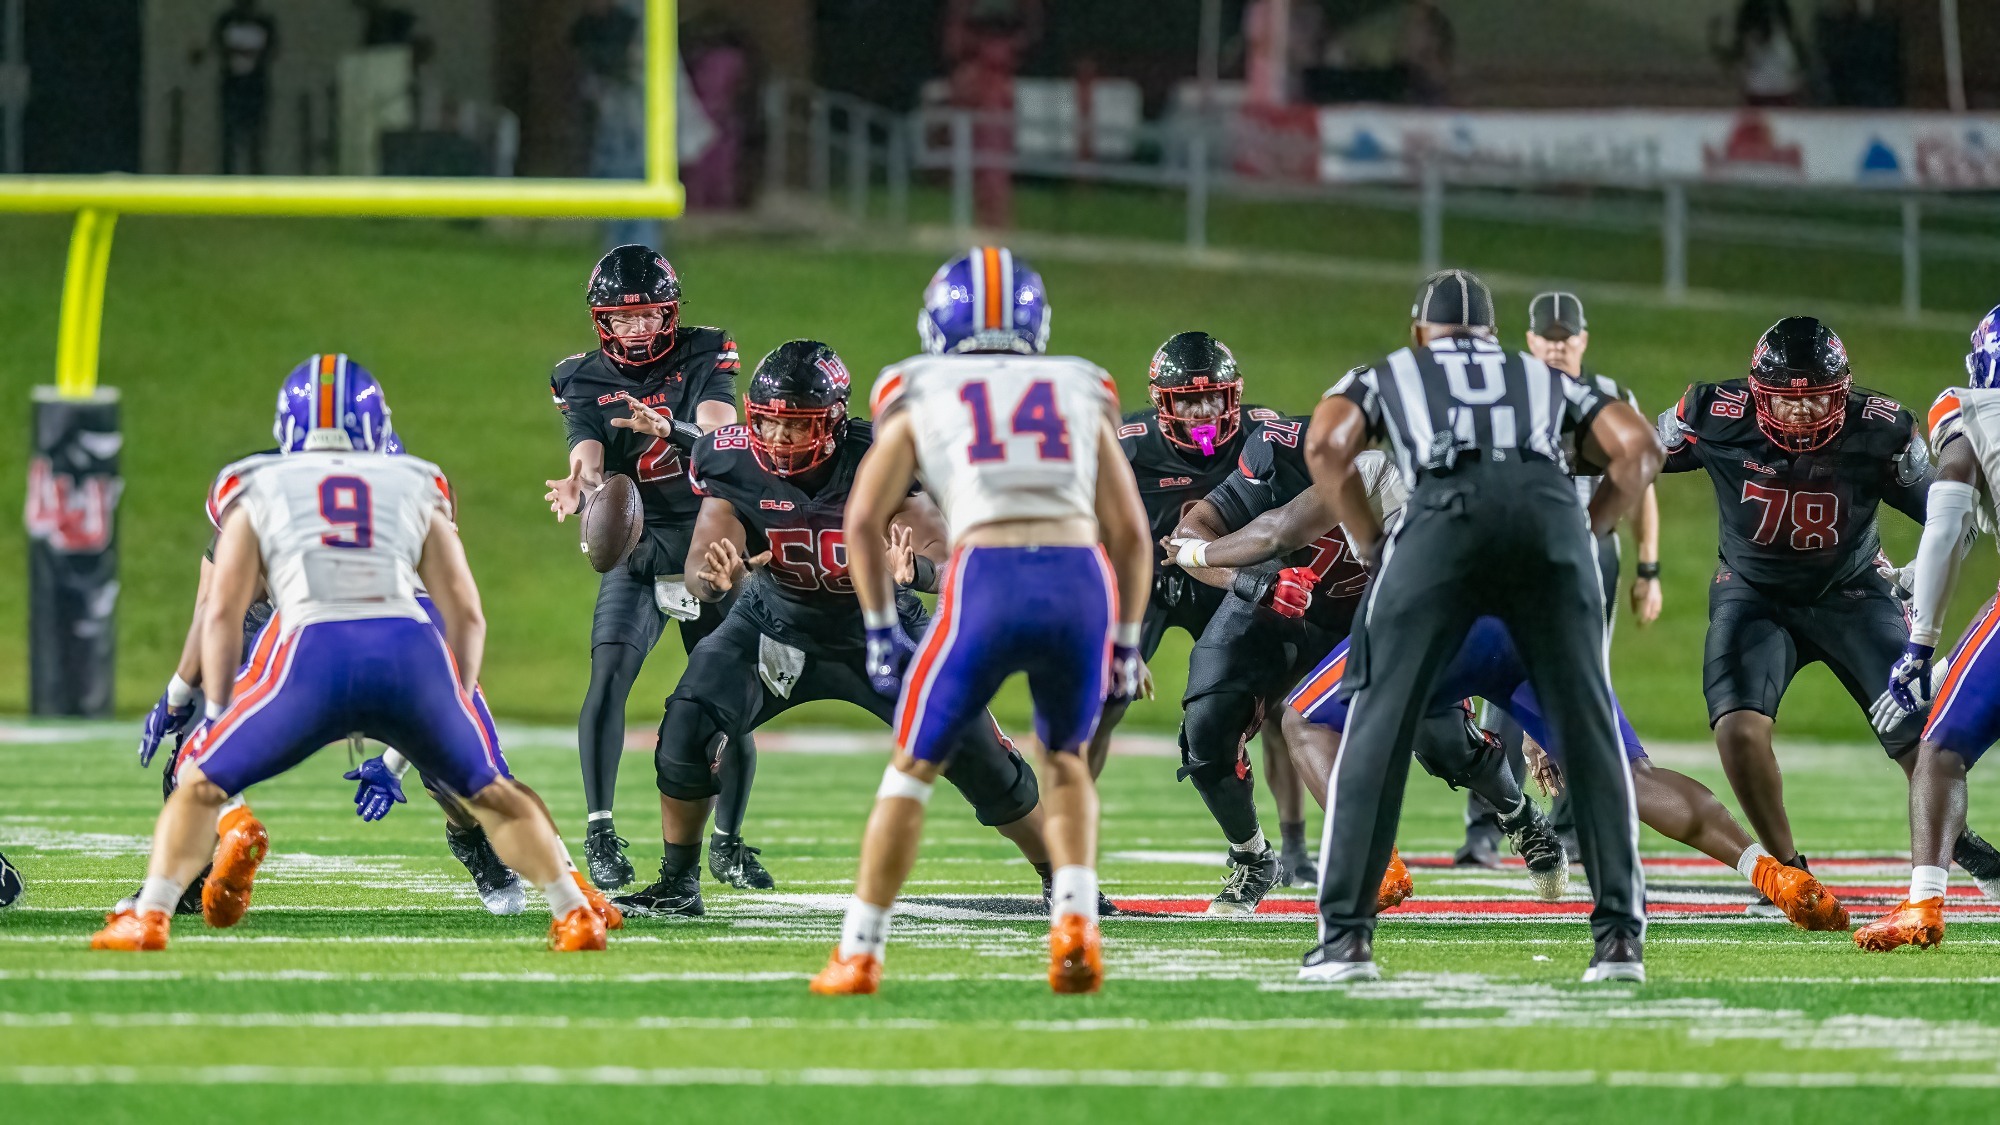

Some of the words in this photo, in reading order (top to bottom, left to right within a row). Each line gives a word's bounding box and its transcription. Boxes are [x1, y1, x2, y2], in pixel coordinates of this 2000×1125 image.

[1433, 351, 1507, 405] U
[1710, 385, 1749, 419] 78
[958, 378, 1072, 465] 14
[1862, 396, 1901, 424] 78
[714, 425, 750, 451] 58
[317, 474, 373, 549] 9
[760, 500, 795, 512] SLC
[1740, 479, 1839, 551] 78
[765, 527, 858, 594] 58
